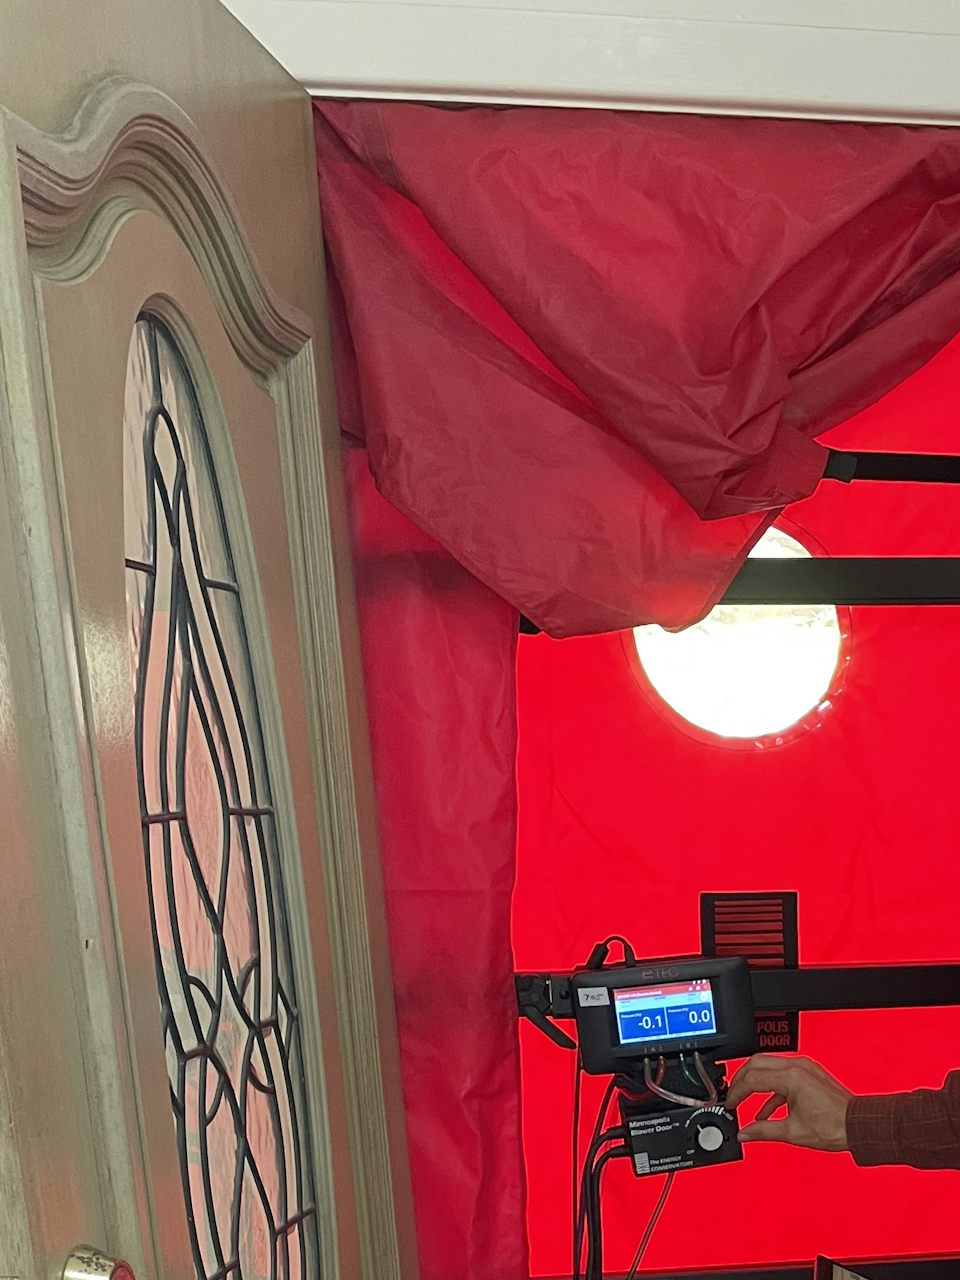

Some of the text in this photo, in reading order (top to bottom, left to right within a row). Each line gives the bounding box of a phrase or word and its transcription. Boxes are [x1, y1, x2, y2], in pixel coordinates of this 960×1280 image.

[638, 1015, 662, 1029] -0.1
[688, 1010, 710, 1024] 0.0
[756, 1020, 789, 1033] POLIS
[760, 1034, 791, 1047] DOOR
[629, 1116, 671, 1128] Minneapolis
[630, 1126, 655, 1136] Blower
